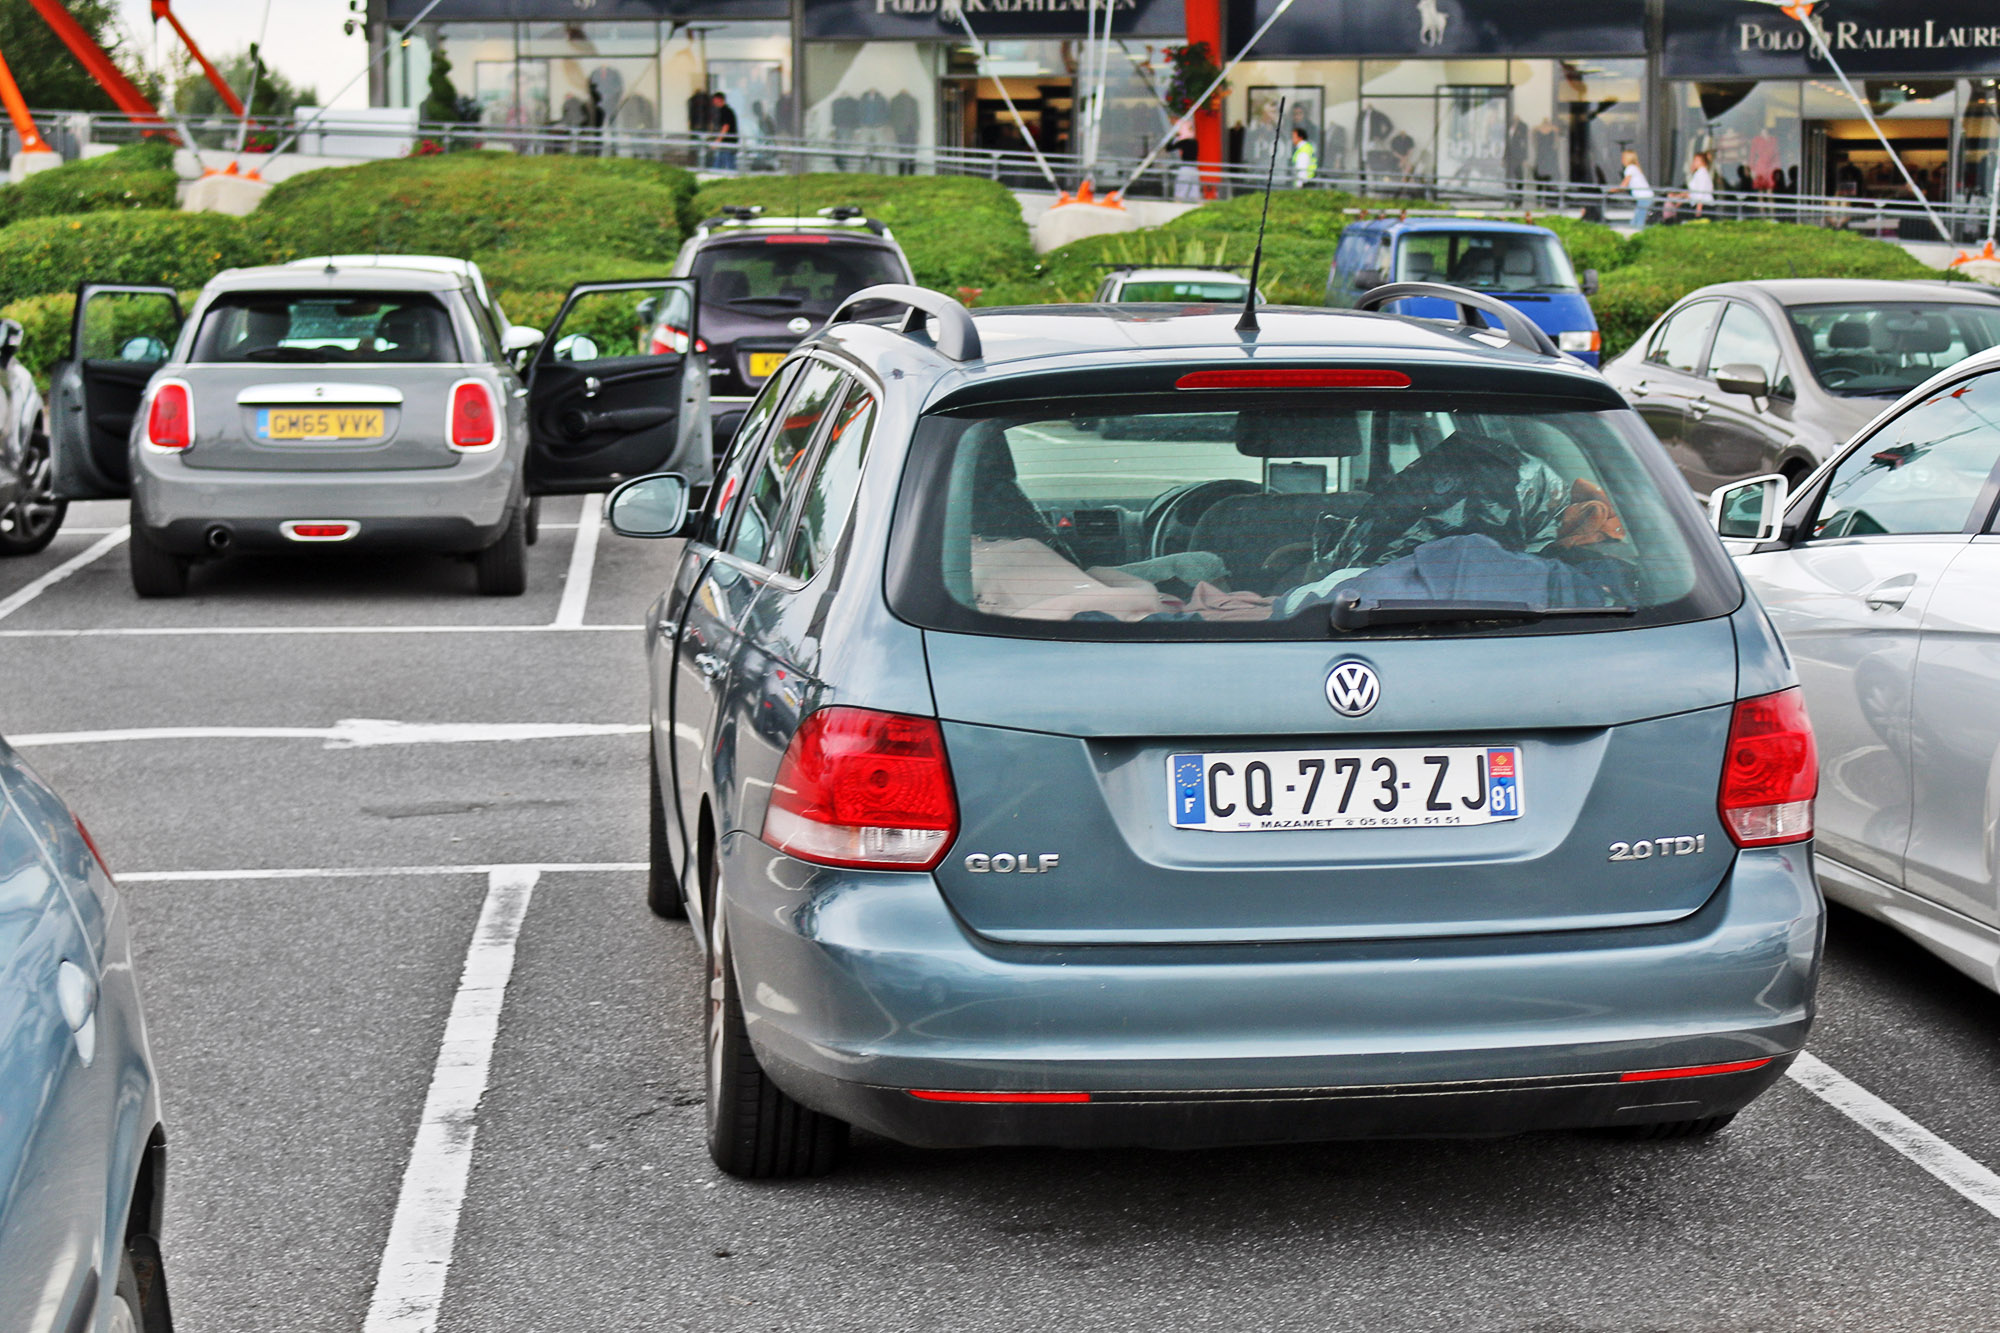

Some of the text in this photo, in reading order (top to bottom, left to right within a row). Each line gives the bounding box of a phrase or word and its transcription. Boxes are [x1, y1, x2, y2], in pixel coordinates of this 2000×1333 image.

[1184, 797, 1197, 814] F
[1491, 785, 1516, 811] 81
[1260, 819, 1335, 829] MAZAMET
[1359, 817, 1377, 826] 05
[1381, 817, 1399, 826] 63
[1424, 816, 1439, 825] 51
[1445, 816, 1461, 824] 51
[964, 852, 1060, 873] GOLF
